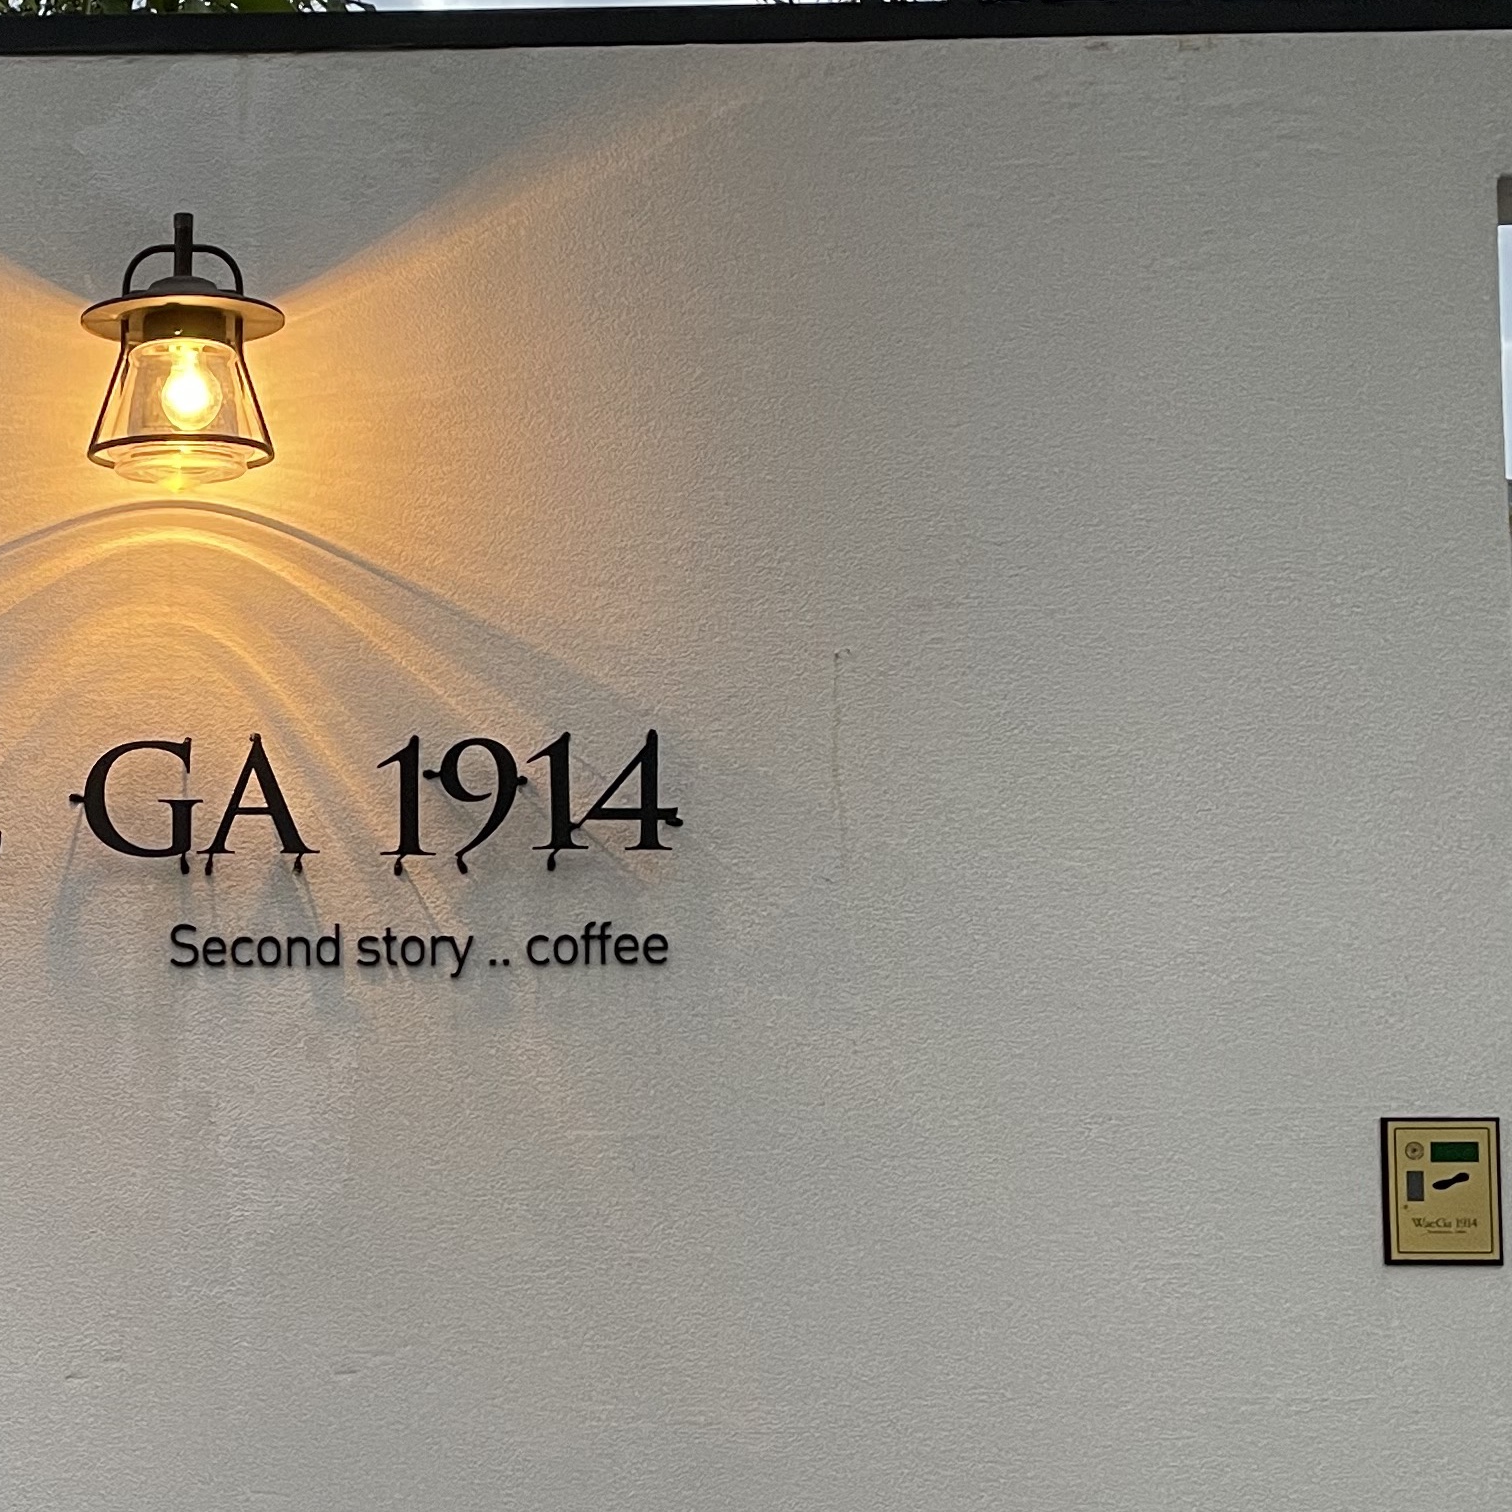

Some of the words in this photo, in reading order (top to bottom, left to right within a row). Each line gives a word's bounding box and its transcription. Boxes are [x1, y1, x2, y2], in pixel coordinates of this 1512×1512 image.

[80, 734, 321, 859] GA
[377, 729, 675, 855] 1914
[170, 922, 341, 970] Second
[357, 926, 475, 981] story
[526, 920, 669, 969] coffee
